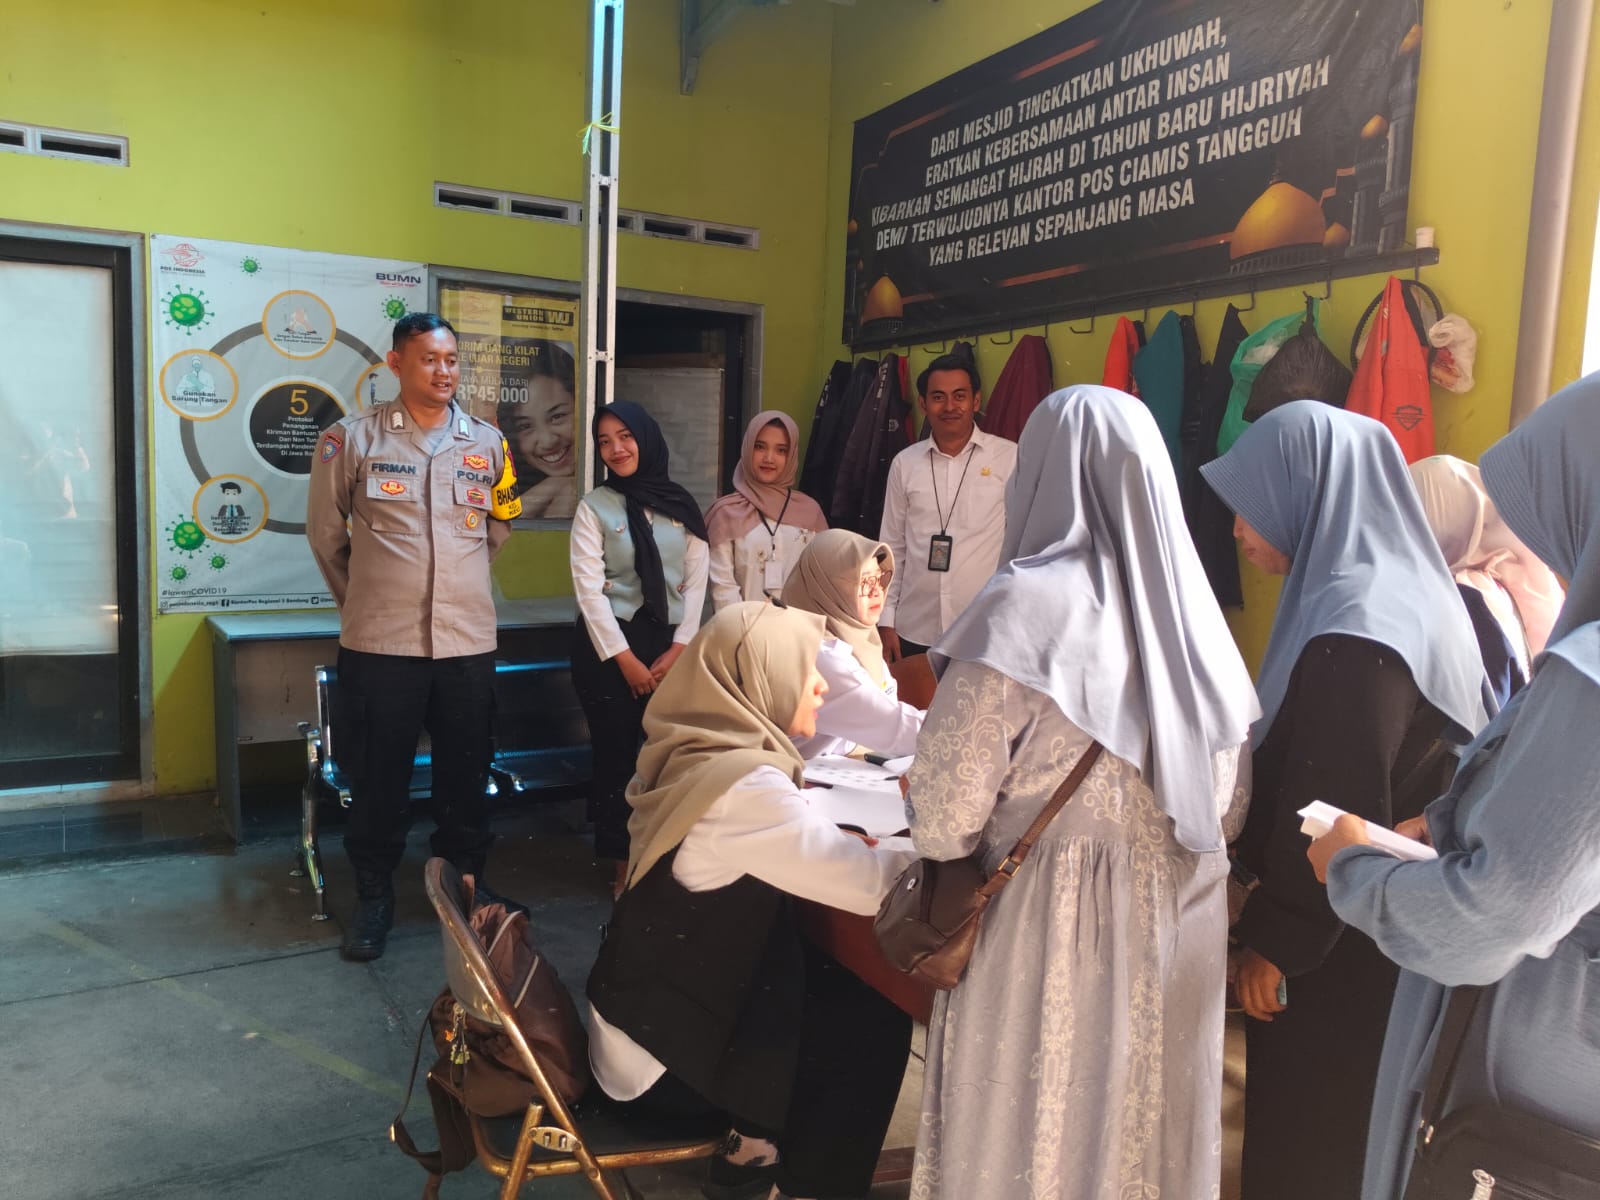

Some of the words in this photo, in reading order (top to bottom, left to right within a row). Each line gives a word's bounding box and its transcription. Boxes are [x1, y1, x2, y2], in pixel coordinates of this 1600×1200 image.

[931, 128, 959, 158] DARI
[963, 104, 1013, 146] MESJID
[1018, 61, 1114, 122] TINGKATKAN
[1120, 17, 1227, 81] UKHUWAH,
[925, 148, 981, 187] ERATKAN
[985, 104, 1095, 166] KEBERSAMAAN
[1100, 79, 1160, 124] ANTAR
[1167, 52, 1230, 100] INSAN
[872, 193, 932, 227] KIBARKAN
[934, 169, 1005, 211] SEMANGAT
[1008, 148, 1063, 188] HIJRAH
[1069, 141, 1086, 168] DI
[1092, 118, 1151, 161] TAHUN
[1157, 96, 1213, 140] BARU
[1221, 55, 1330, 120] HIJRIYAH
[876, 226, 907, 250] DEMI
[912, 198, 1008, 243] TERWUJUDNYA
[1013, 182, 1074, 217] KANTOR
[1080, 169, 1114, 199] POS
[1120, 142, 1190, 186] CIAMIS
[1197, 106, 1302, 165] TANGGUH
[929, 240, 964, 266] YANG
[967, 222, 1031, 259] RELEVAN
[1035, 197, 1131, 242] SEPANJANG
[1138, 178, 1194, 217] MASA
[375, 272, 421, 284] BUMN
[504, 307, 544, 316] WESTERN
[515, 313, 544, 322] UNION
[515, 345, 540, 356] KILAT
[496, 355, 530, 366] NEGERI
[509, 377, 529, 387] DARI
[290, 389, 309, 416] 5
[371, 462, 417, 474] FIRMAN
[457, 470, 493, 484] POLRI
